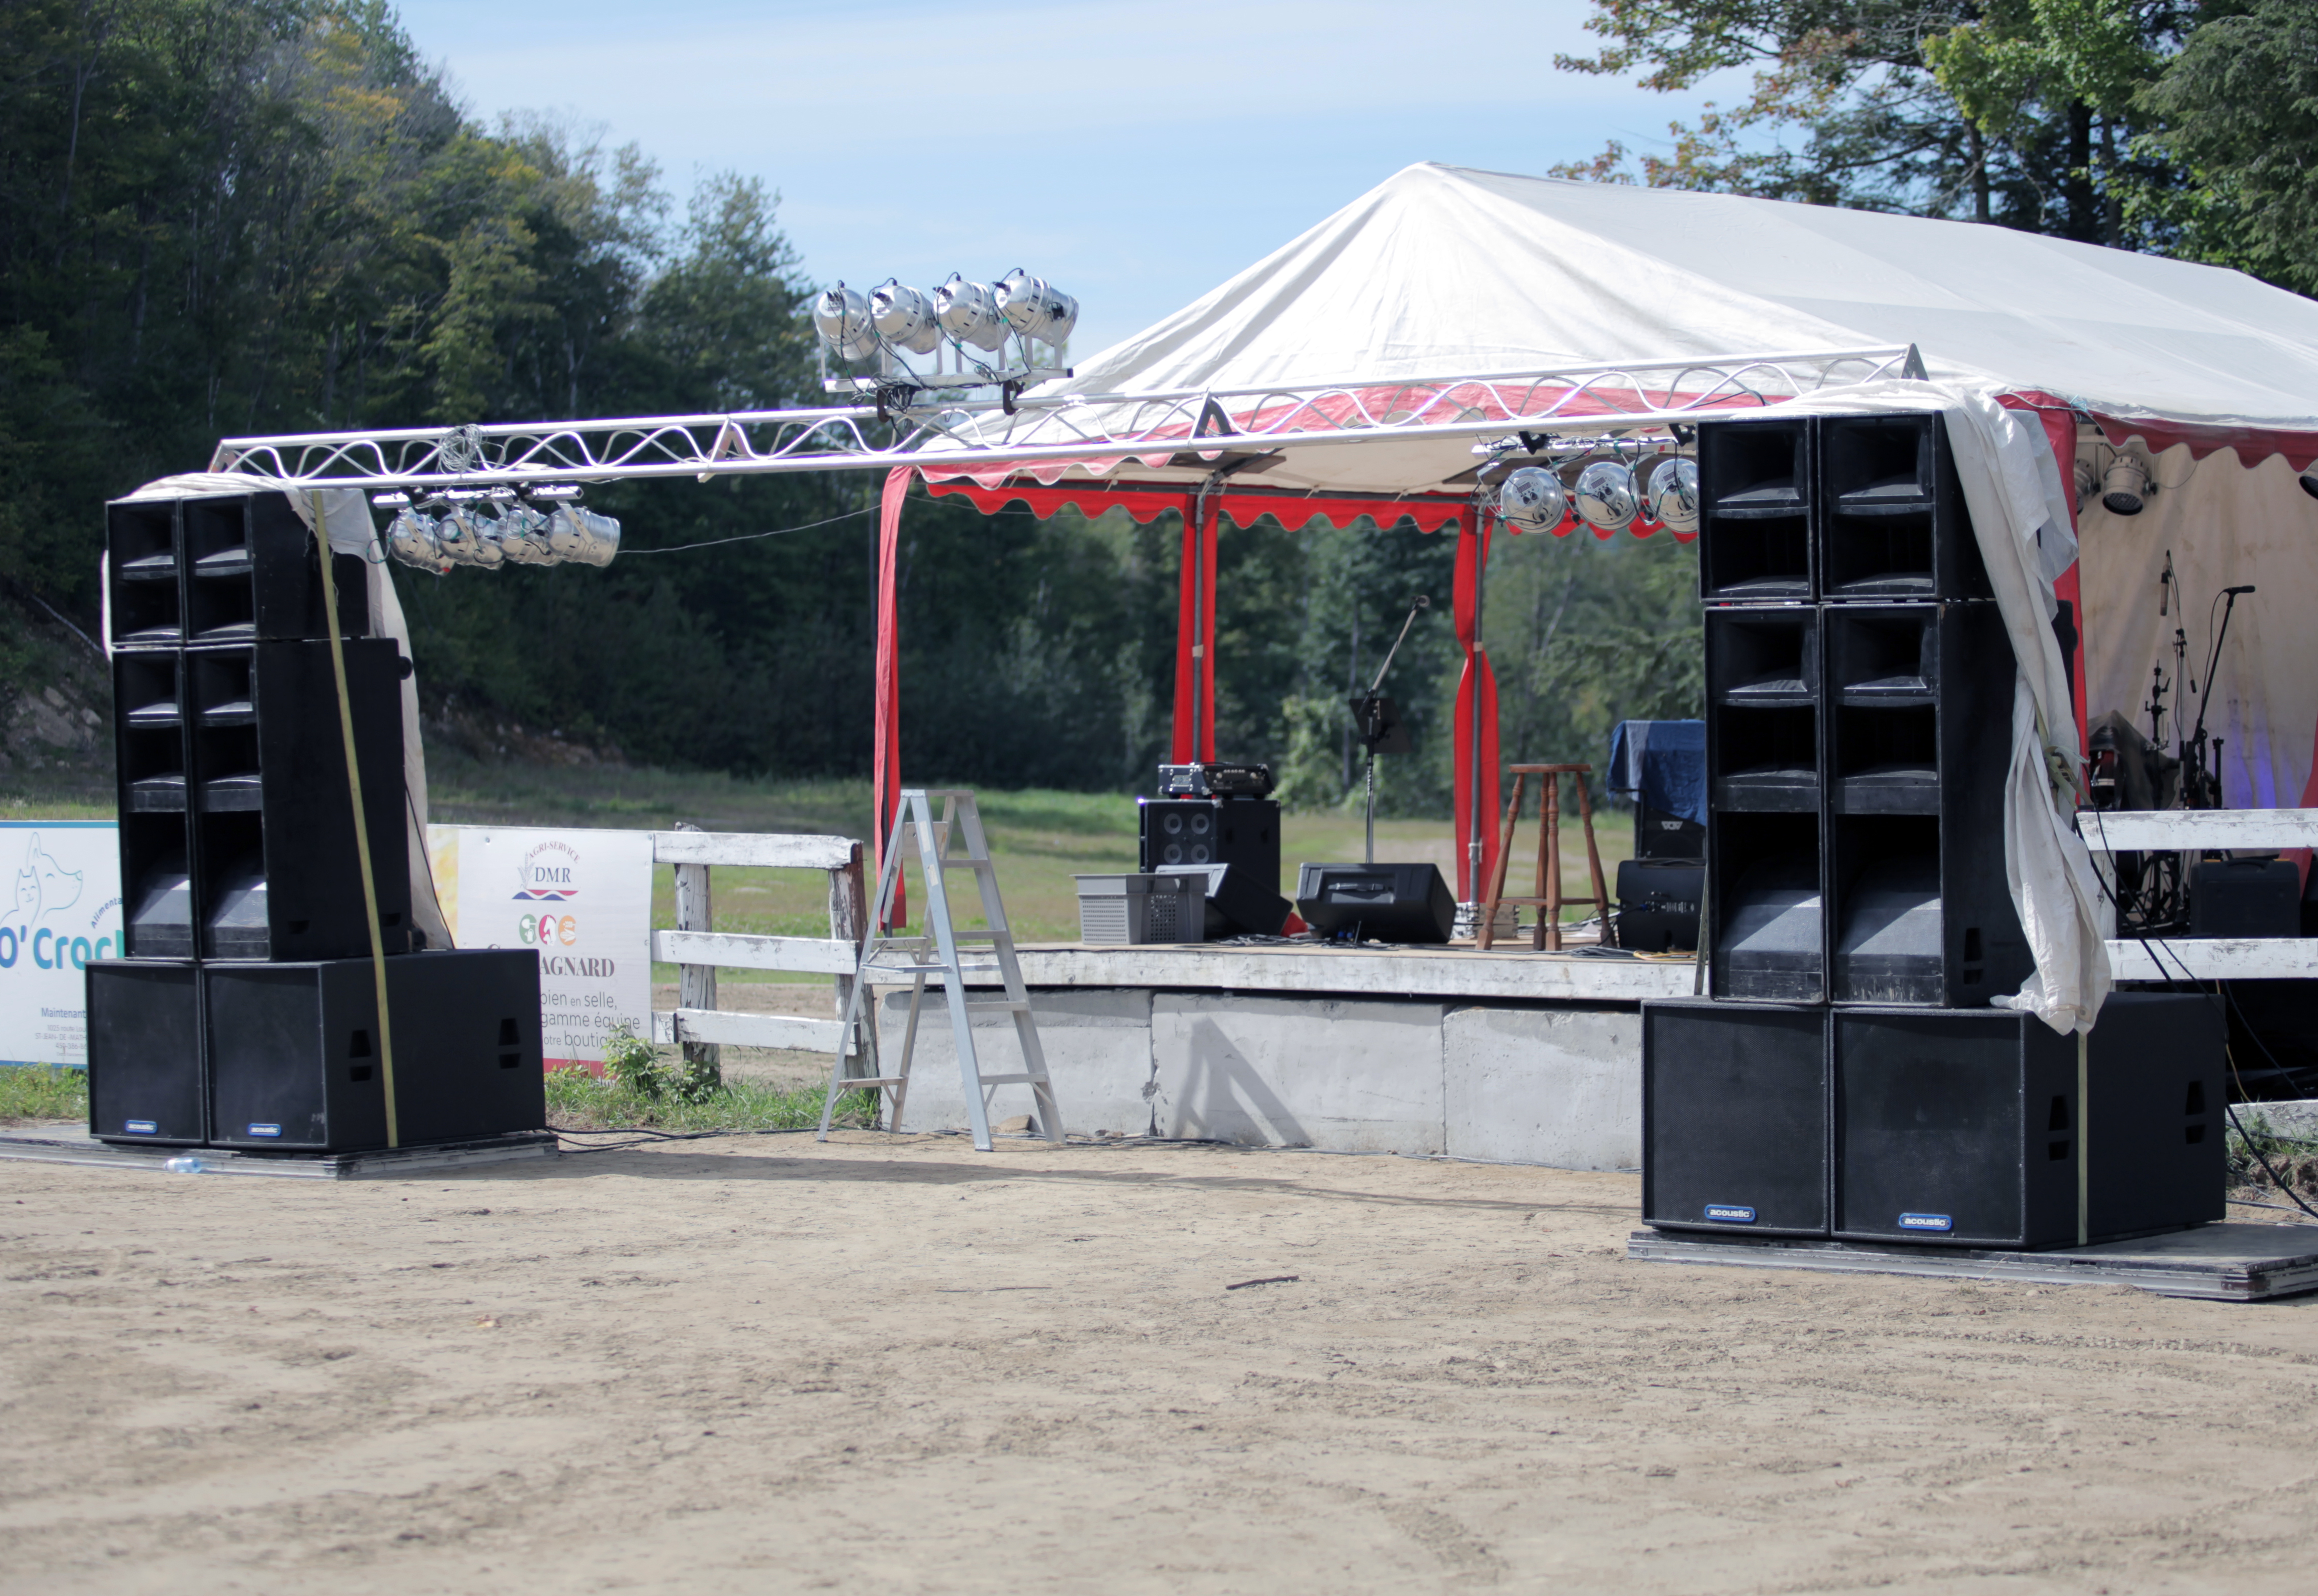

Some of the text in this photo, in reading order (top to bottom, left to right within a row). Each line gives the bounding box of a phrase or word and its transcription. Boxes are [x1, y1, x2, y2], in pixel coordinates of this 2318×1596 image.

[529, 841, 580, 864] AGRI-SERVICE
[535, 867, 571, 883] DMR
[540, 956, 615, 977] AGNARD
[570, 998, 581, 1006] en
[584, 991, 617, 1010] selle,
[41, 1007, 86, 1018] Maintenant
[541, 1012, 640, 1032] gamme équine
[1710, 1209, 1750, 1218] acoustic
[1904, 1218, 1946, 1226] acoustic
